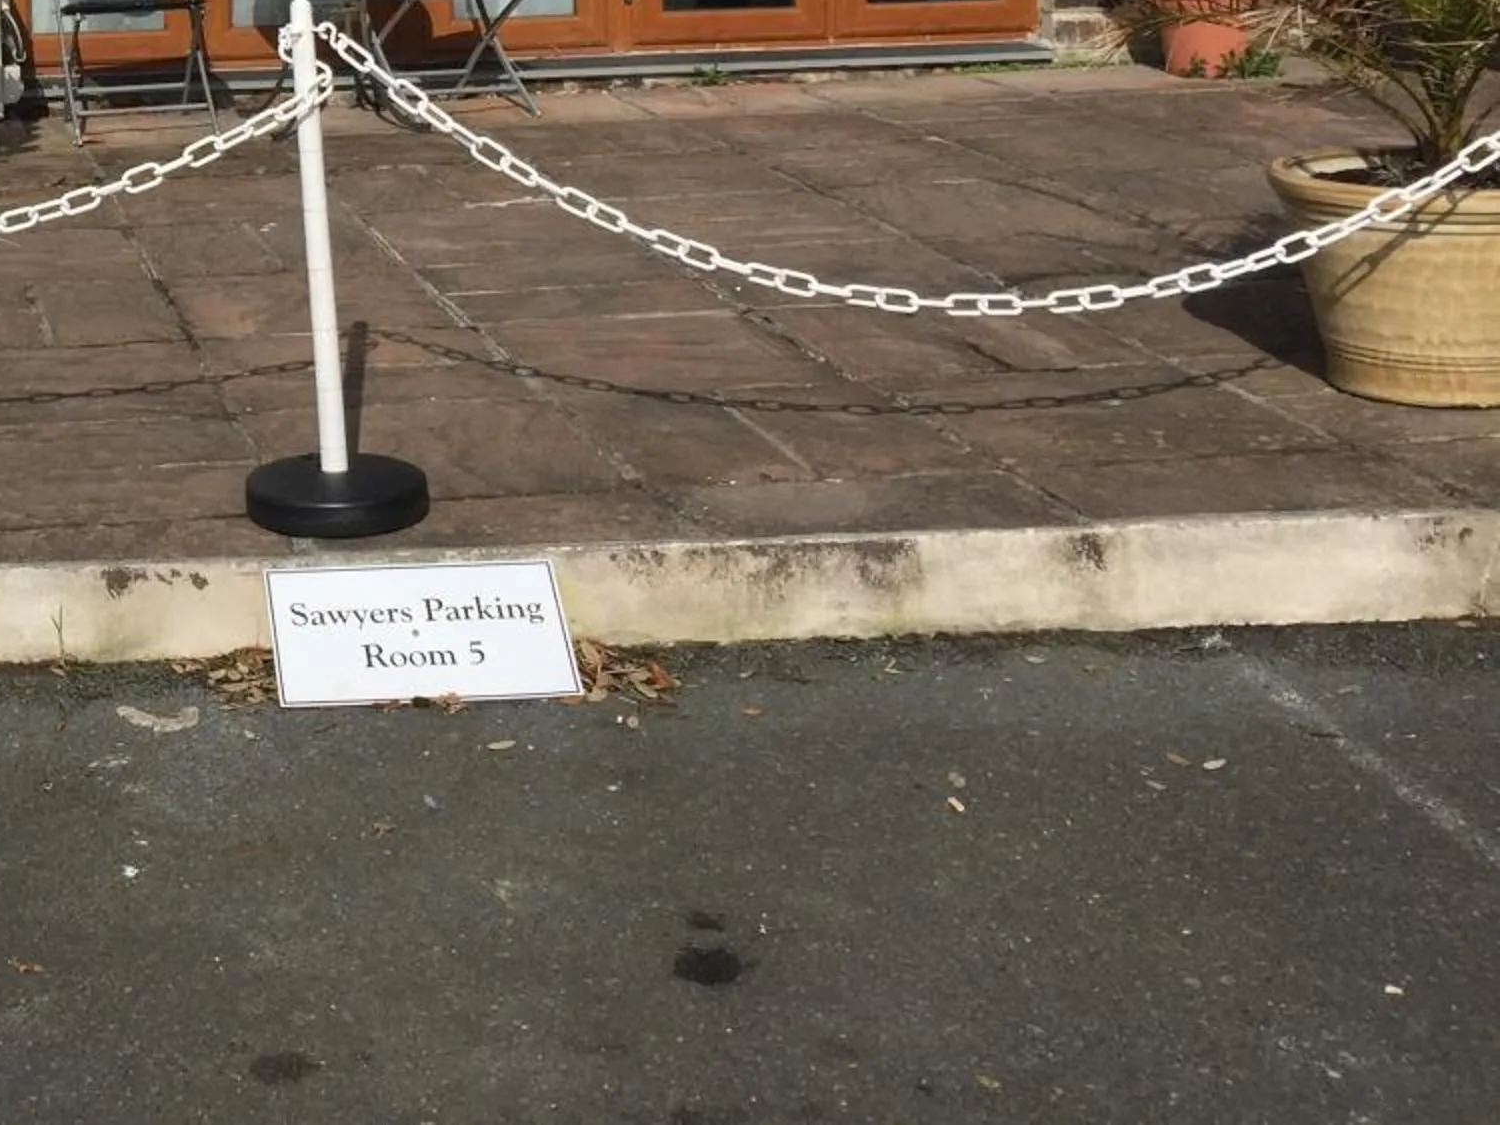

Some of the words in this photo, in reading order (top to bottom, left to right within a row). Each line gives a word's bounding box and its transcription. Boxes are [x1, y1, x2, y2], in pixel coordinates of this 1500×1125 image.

[288, 601, 413, 631] Sawyers
[421, 595, 546, 624] Parking
[360, 642, 458, 669] Room
[468, 639, 486, 666] 5
